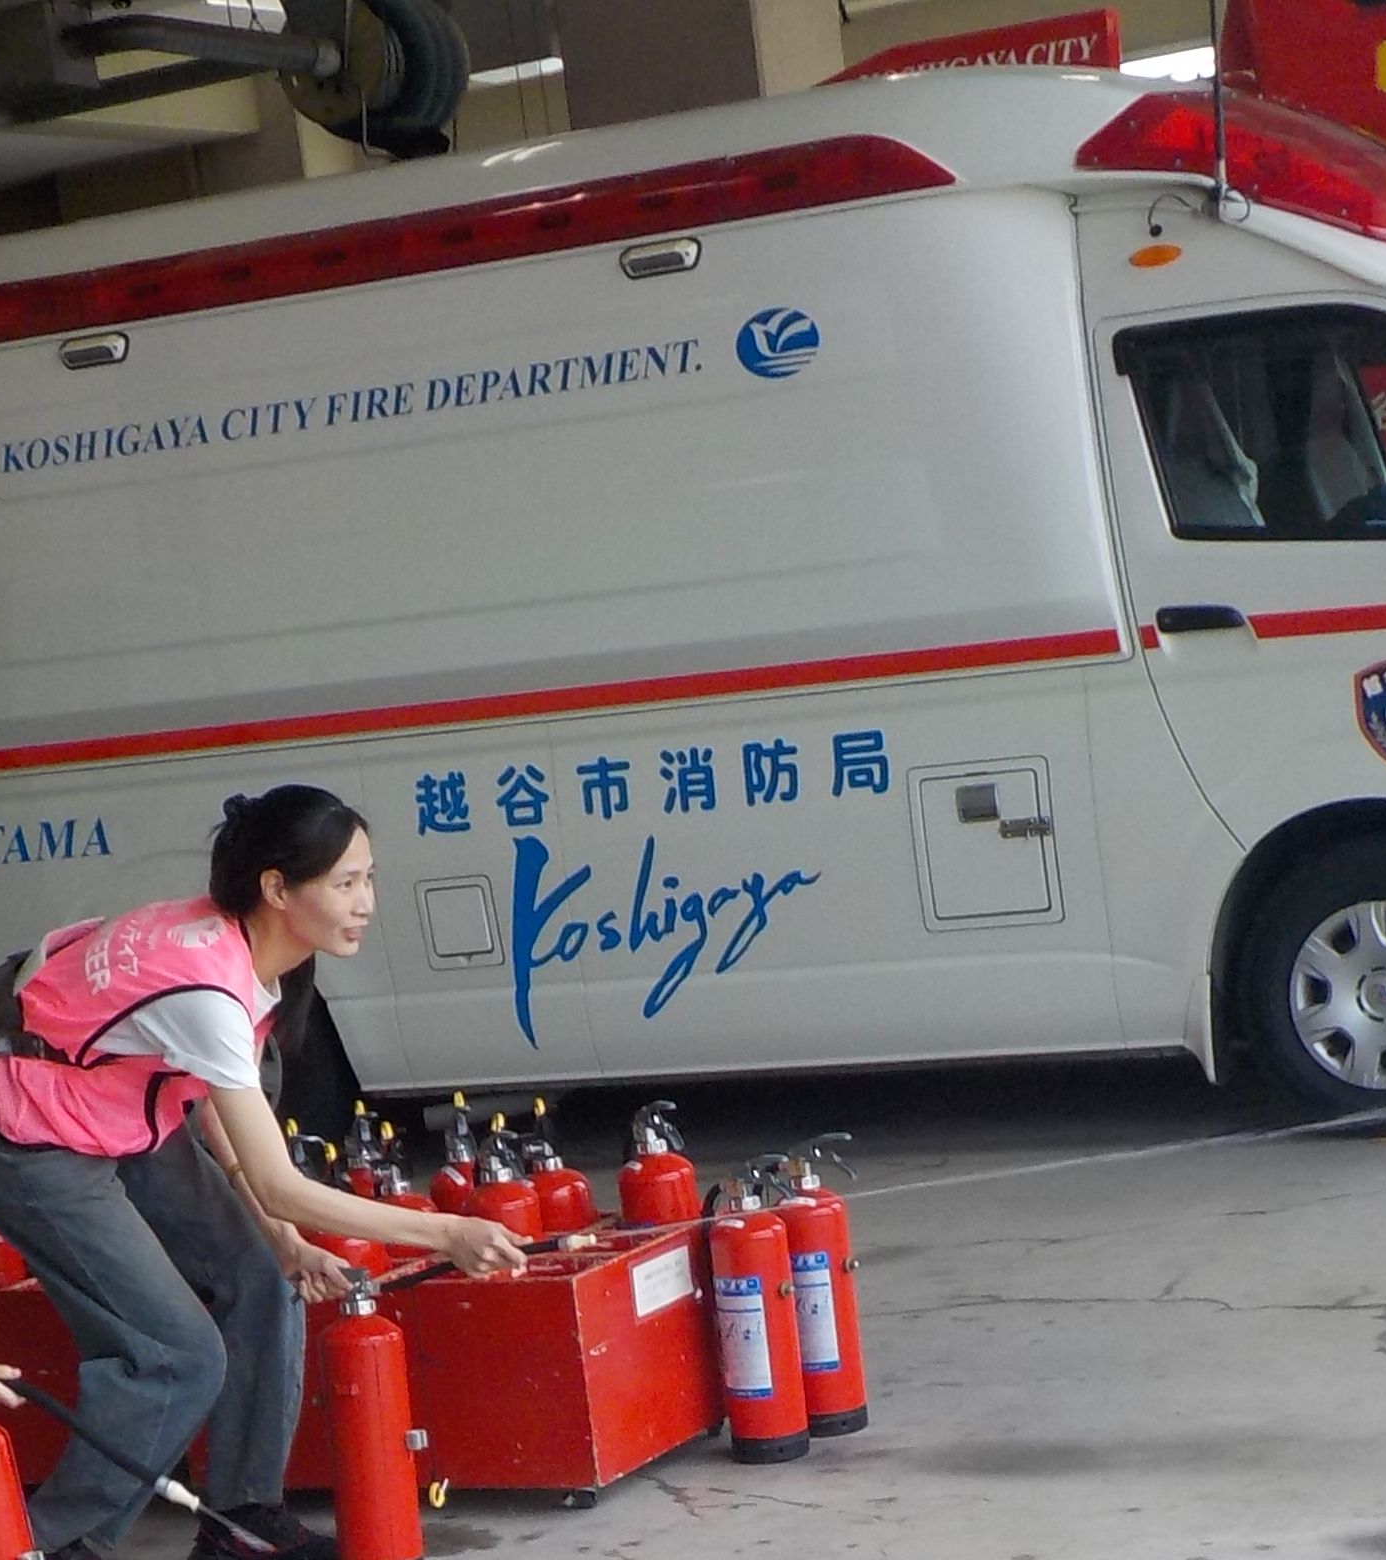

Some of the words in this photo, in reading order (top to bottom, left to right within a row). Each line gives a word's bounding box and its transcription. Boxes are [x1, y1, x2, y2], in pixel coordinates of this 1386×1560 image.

[1026, 34, 1098, 67] CITY
[1, 413, 210, 473] KOSHIGAYA
[219, 396, 318, 442] CITY
[325, 381, 416, 427] FIRE
[424, 338, 704, 412] DEPARTMENT.
[414, 729, 890, 836] 越谷市消防局
[512, 834, 822, 1049] Koshigaya
